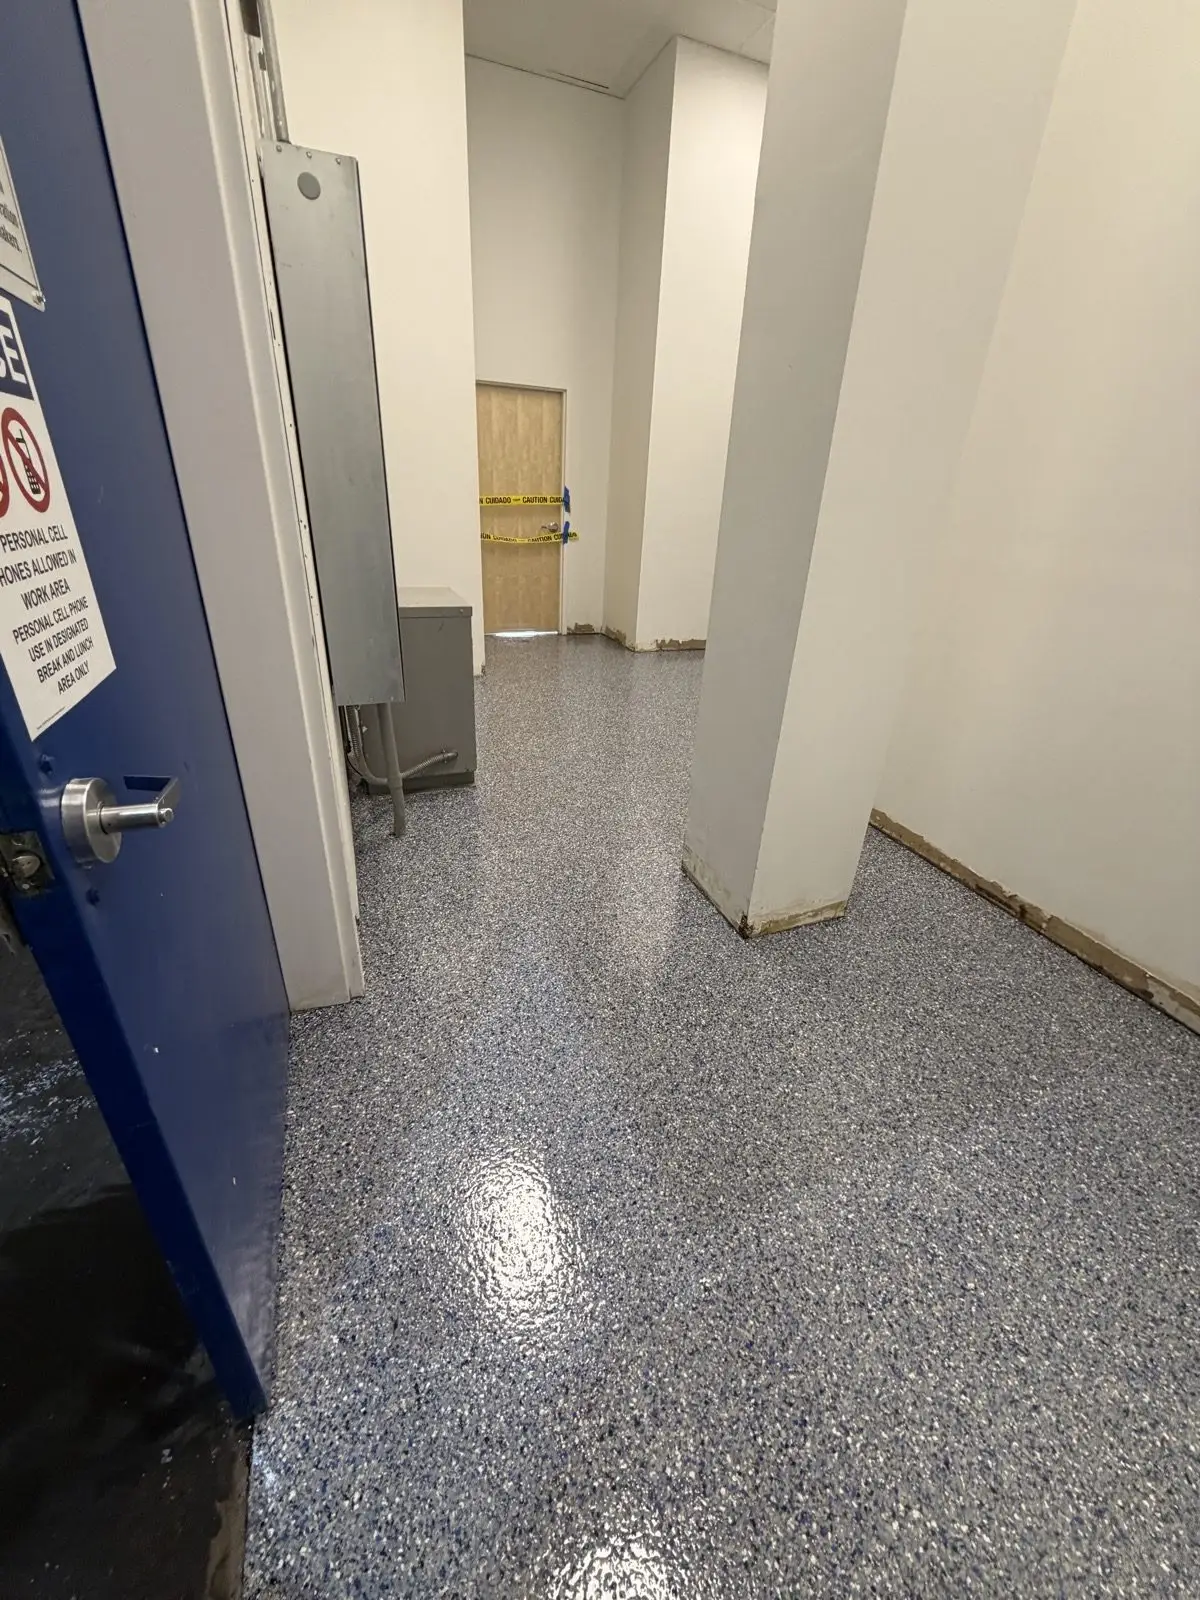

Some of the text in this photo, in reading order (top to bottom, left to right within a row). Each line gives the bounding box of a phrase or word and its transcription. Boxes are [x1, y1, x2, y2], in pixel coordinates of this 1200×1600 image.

[485, 496, 511, 504] CUIDADO
[522, 496, 548, 504] CAUTION
[0, 525, 68, 553] PERSONAL CELL
[32, 550, 69, 576] ALLOWED
[68, 548, 77, 564] IN
[21, 578, 71, 610] WORK AREA
[12, 596, 88, 645] PERSONAL CELL PHONE
[28, 617, 89, 662] USE IN DESIGNATED
[37, 636, 94, 683] BREAK AND LUNCH
[57, 660, 90, 695] AREA ONLY
